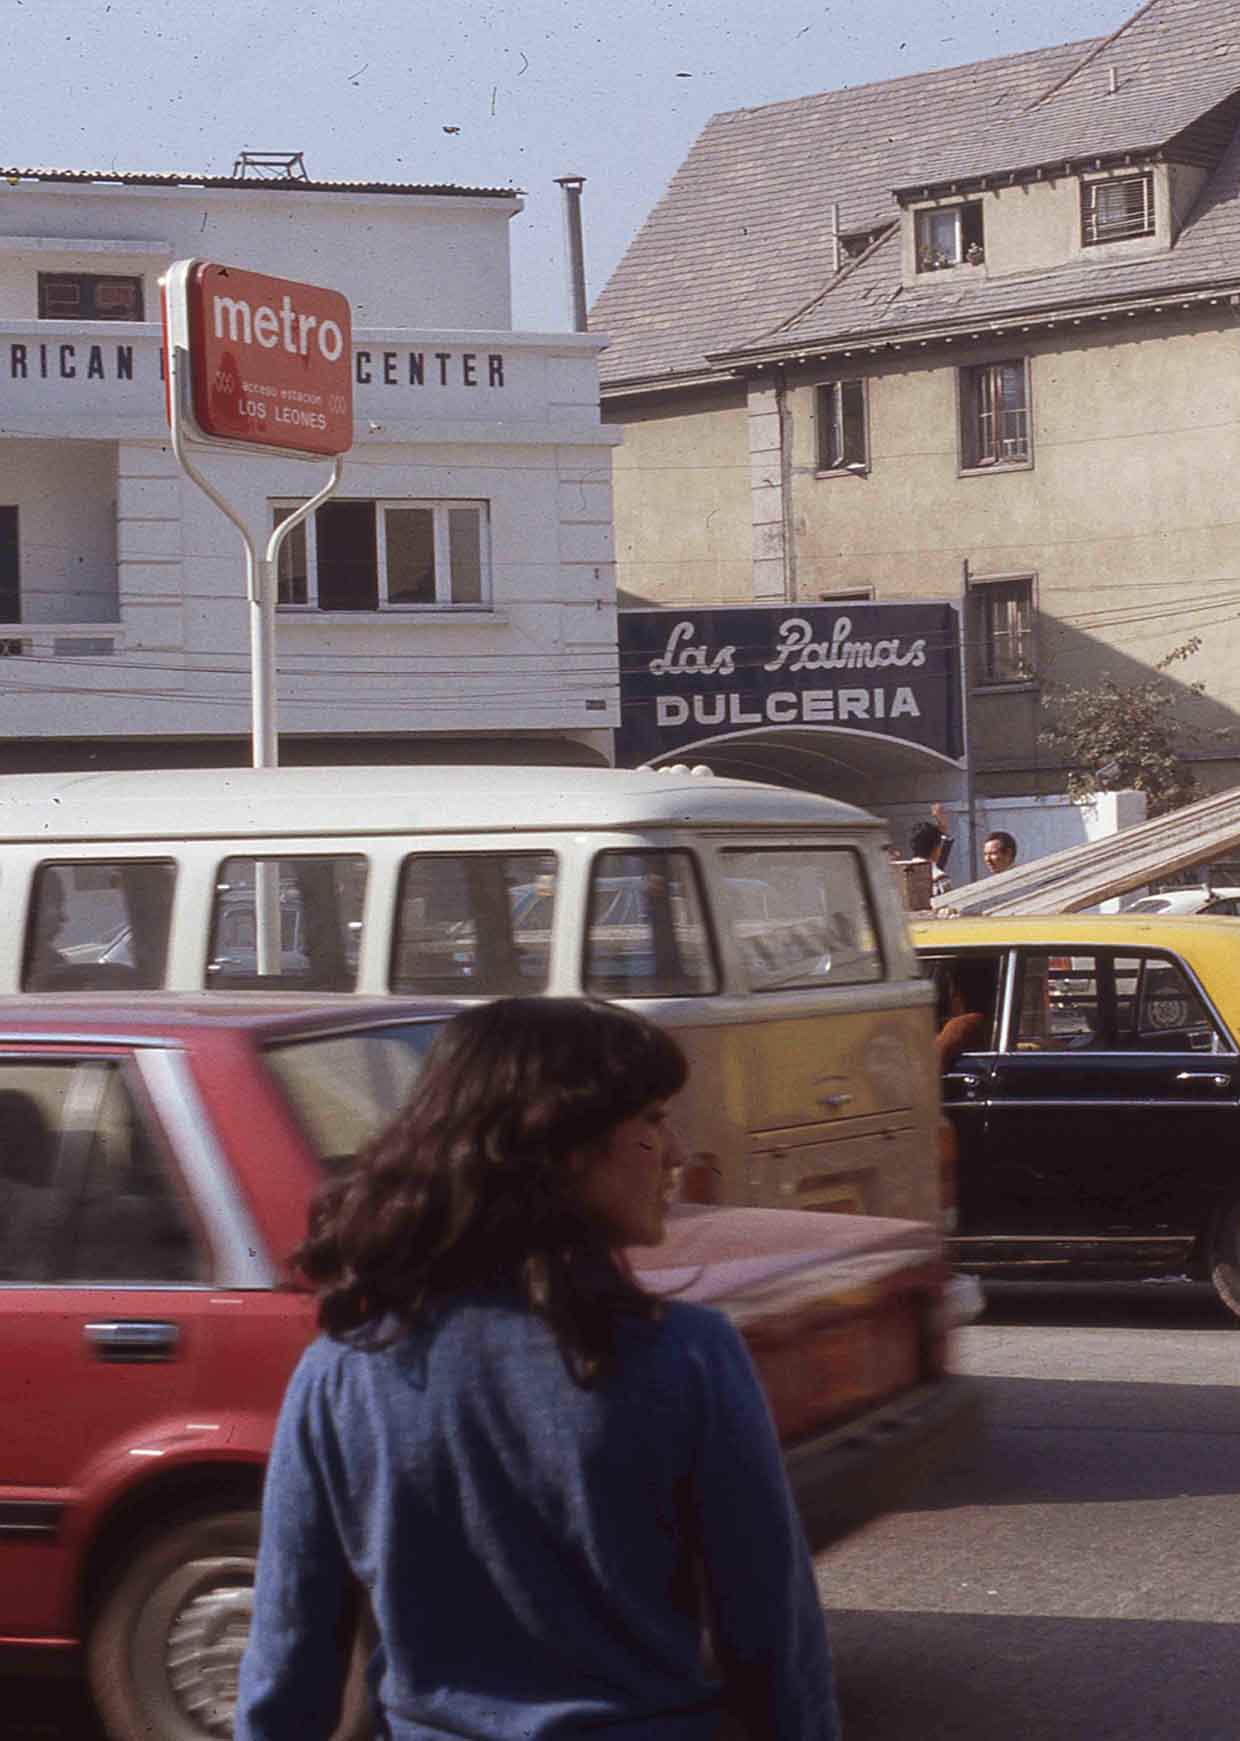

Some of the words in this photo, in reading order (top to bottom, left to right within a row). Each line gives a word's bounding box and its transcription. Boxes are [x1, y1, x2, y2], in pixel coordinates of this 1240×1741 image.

[213, 295, 343, 361] metro
[356, 351, 504, 388] CENTER
[238, 399, 266, 419] LOS
[273, 404, 327, 430] LEONES
[648, 621, 737, 676] Las
[763, 616, 927, 672] Palmas
[656, 687, 921, 727] DULCERIA
